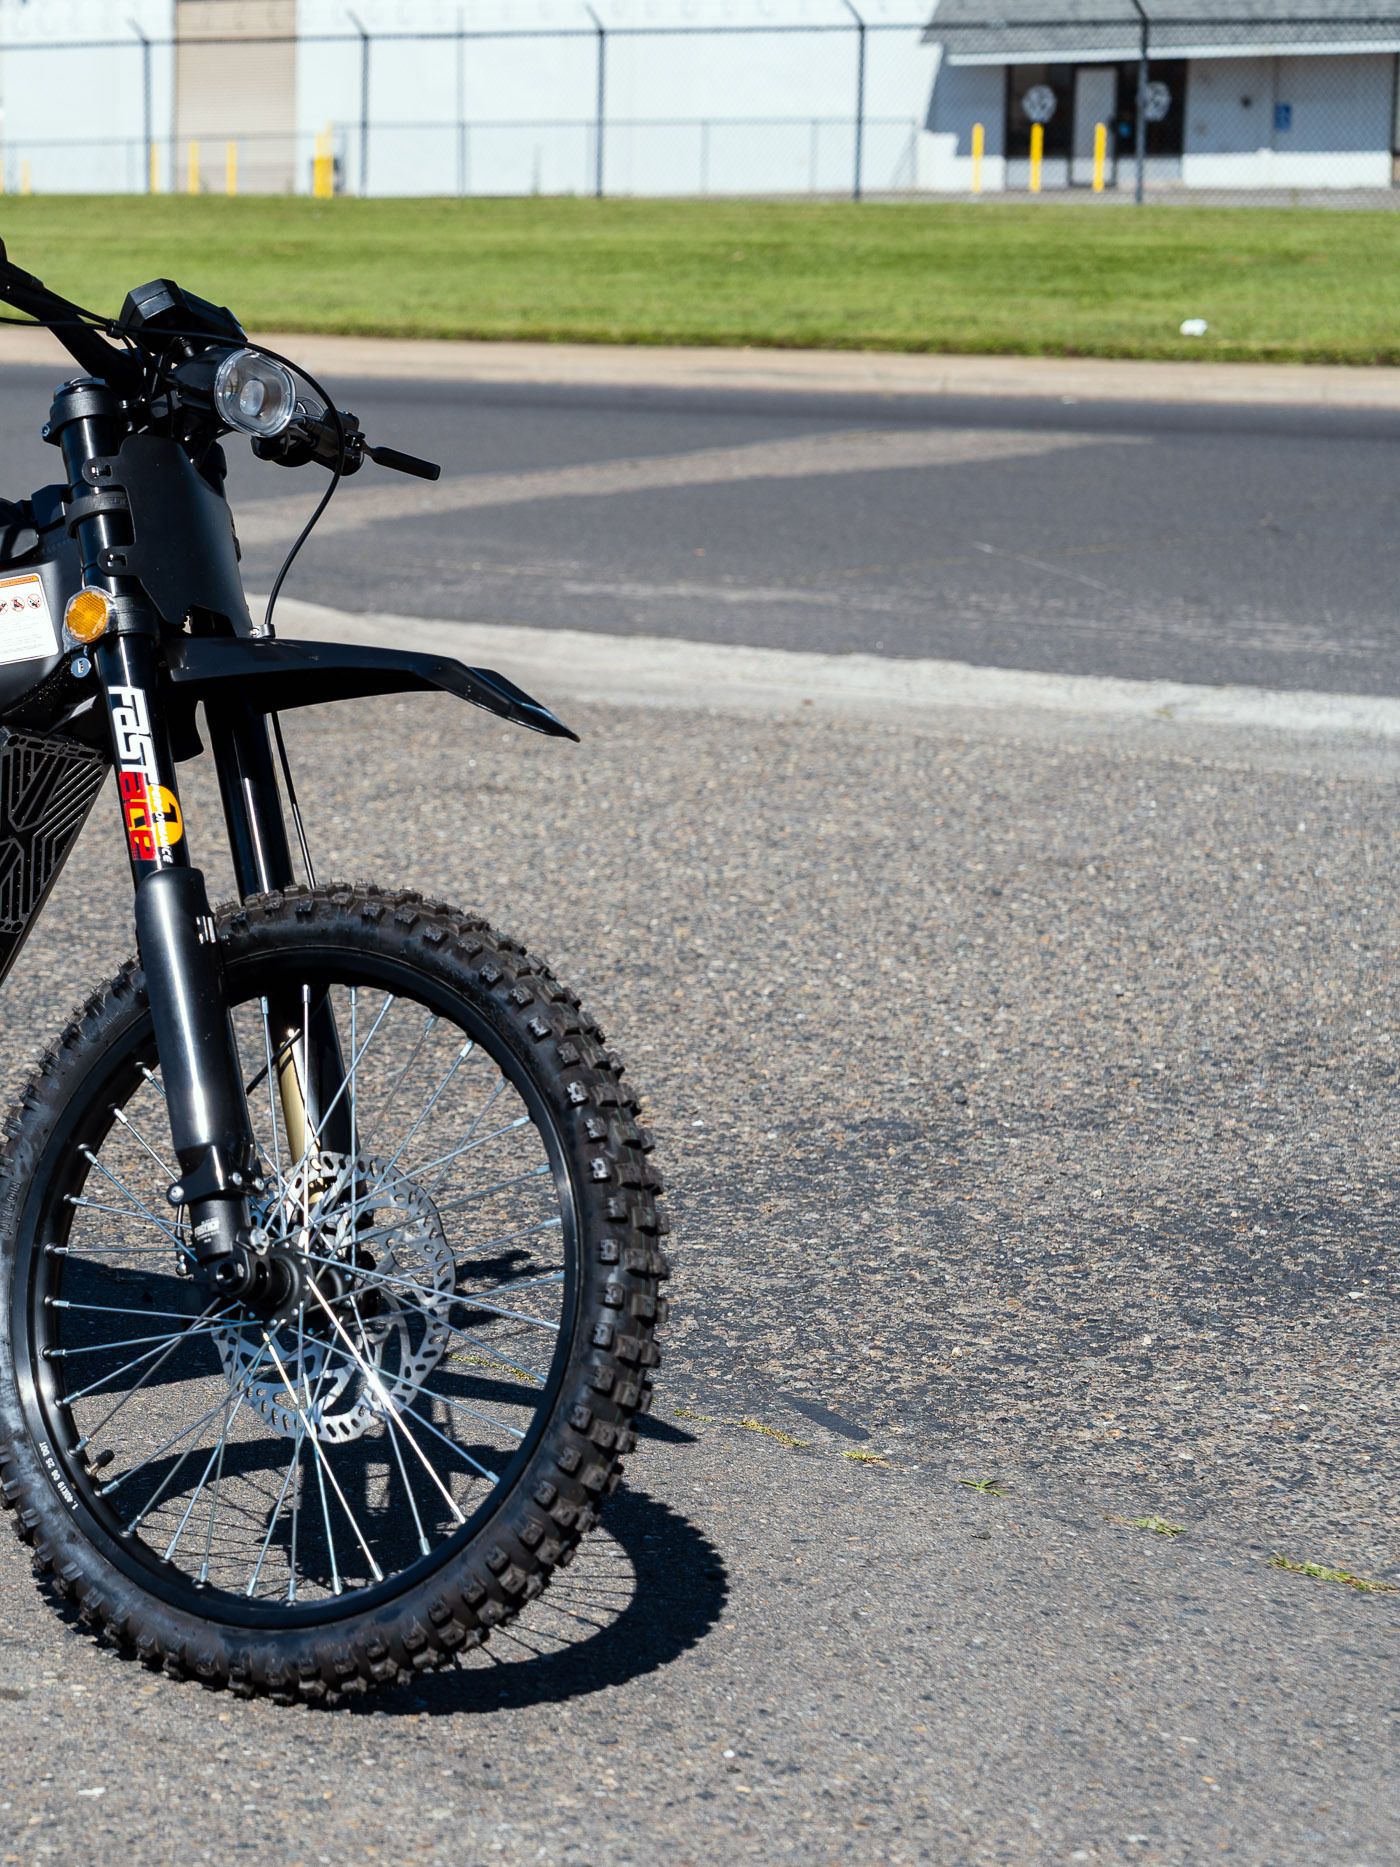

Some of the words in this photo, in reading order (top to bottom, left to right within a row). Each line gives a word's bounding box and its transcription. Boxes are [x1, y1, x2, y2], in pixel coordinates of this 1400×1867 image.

[0, 1180, 22, 1233] NYLON
[38, 1441, 51, 1457] DOT
[45, 1457, 56, 1469] 25
